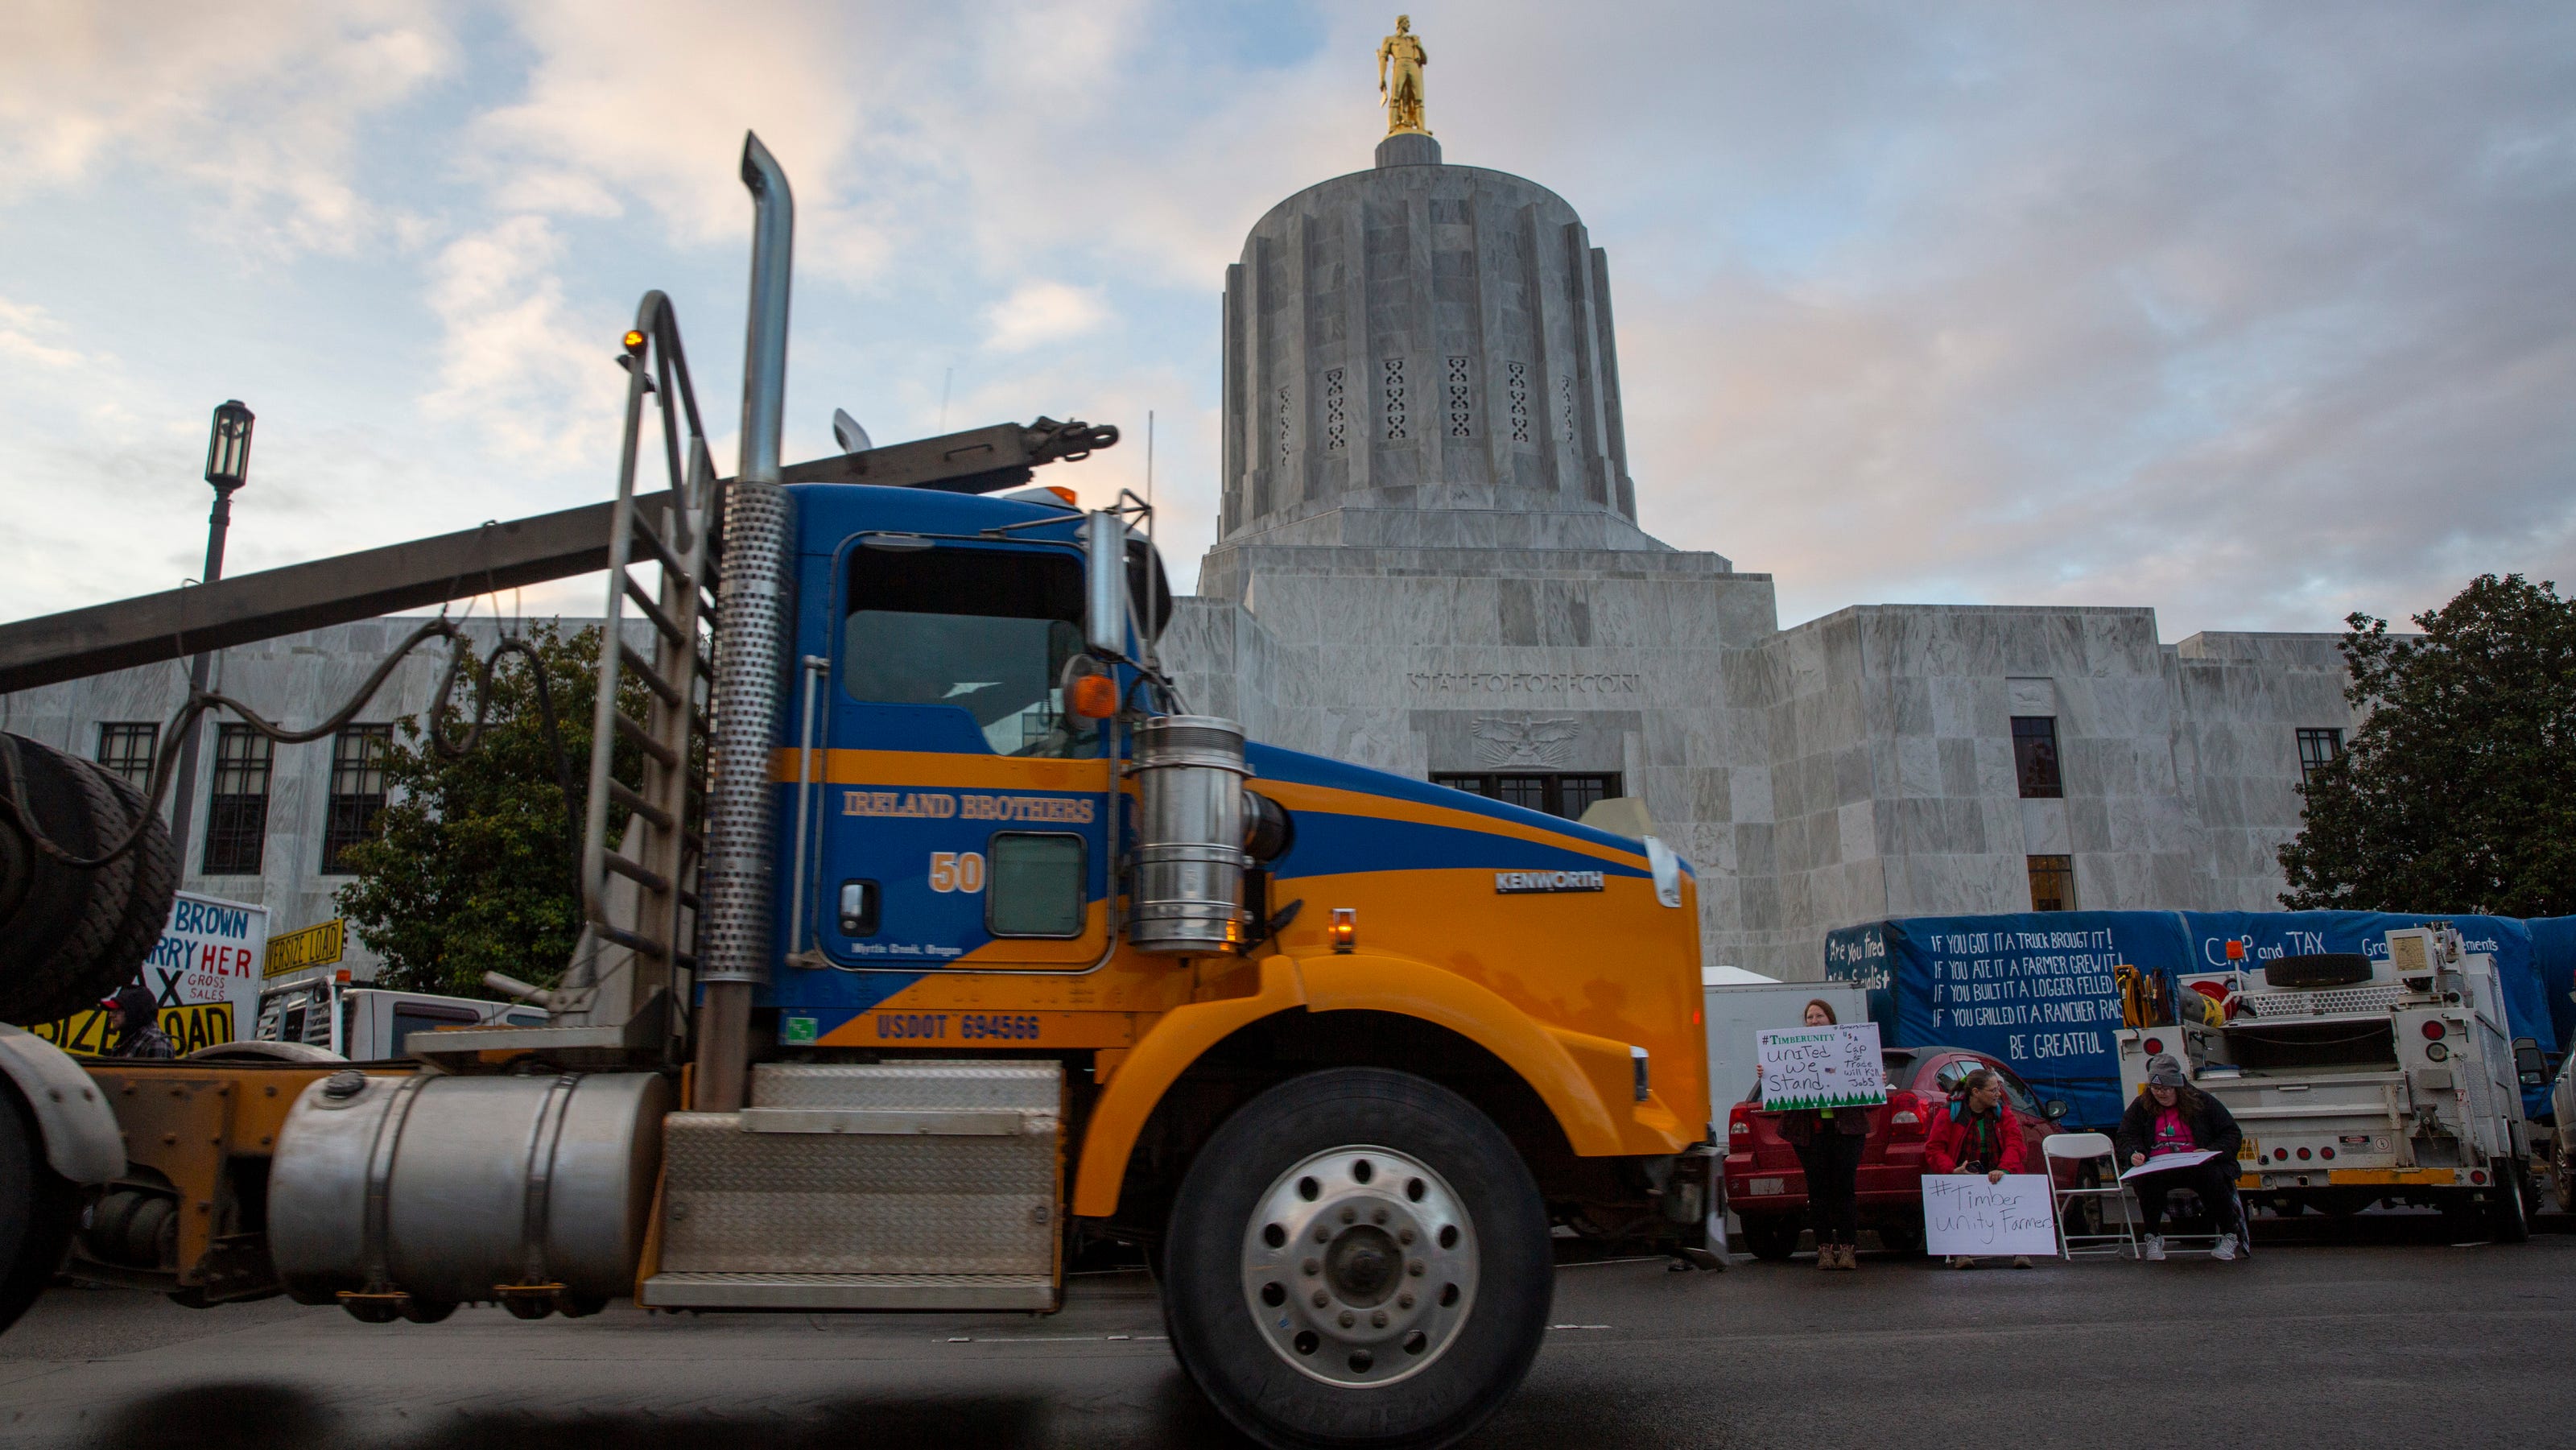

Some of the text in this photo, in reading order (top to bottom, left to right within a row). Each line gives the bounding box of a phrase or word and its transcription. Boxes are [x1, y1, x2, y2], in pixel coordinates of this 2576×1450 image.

[1407, 671, 1641, 693] STATE OF OREGON
[842, 791, 1094, 824] IRELAND BROTHERS
[928, 851, 986, 894] 50
[1496, 871, 1604, 890] KENWORTH
[175, 900, 249, 940] BROWN
[309, 927, 336, 960] LOAD
[1829, 938, 1846, 962] Are
[1930, 935, 1942, 953] IF
[1946, 933, 1967, 955] YOU
[1968, 932, 1990, 954] GOT
[1994, 932, 2004, 952] IT
[2004, 932, 2016, 952] A
[2050, 930, 2089, 950] BROUGT
[2205, 931, 2327, 967] CP and TAX
[2362, 937, 2388, 956] Gra
[144, 936, 253, 979] RRY HER
[1934, 960, 1943, 980] IF
[1948, 959, 1969, 981] YOU
[1972, 958, 1993, 980] ATE
[1994, 958, 2004, 978] IT
[2009, 958, 2021, 977] A
[2021, 955, 2068, 977] FARMER
[2068, 952, 2103, 976] GREW
[187, 973, 225, 989] GROSS
[189, 988, 225, 1002] SALES
[1934, 984, 1945, 1003] IF
[1950, 983, 1971, 1003] YOU
[1973, 981, 2001, 1002] BUILT
[2002, 980, 2015, 1000] IT
[2018, 979, 2029, 999] A
[2032, 977, 2074, 998] LOGGER
[2076, 975, 2113, 996] FELLED
[876, 1014, 1040, 1040] USDOT 694566
[1933, 1008, 1945, 1029] IF
[1951, 1006, 1974, 1027] YOU
[1974, 1006, 2014, 1027] GRILLED
[2015, 1005, 2028, 1026] IT
[2029, 1004, 2042, 1025] A
[2042, 1000, 2098, 1025] RANCHER
[163, 1006, 230, 1056] OAD
[1844, 1043, 1868, 1054] Cap
[2009, 1031, 2106, 1060] BE GREATFUL
